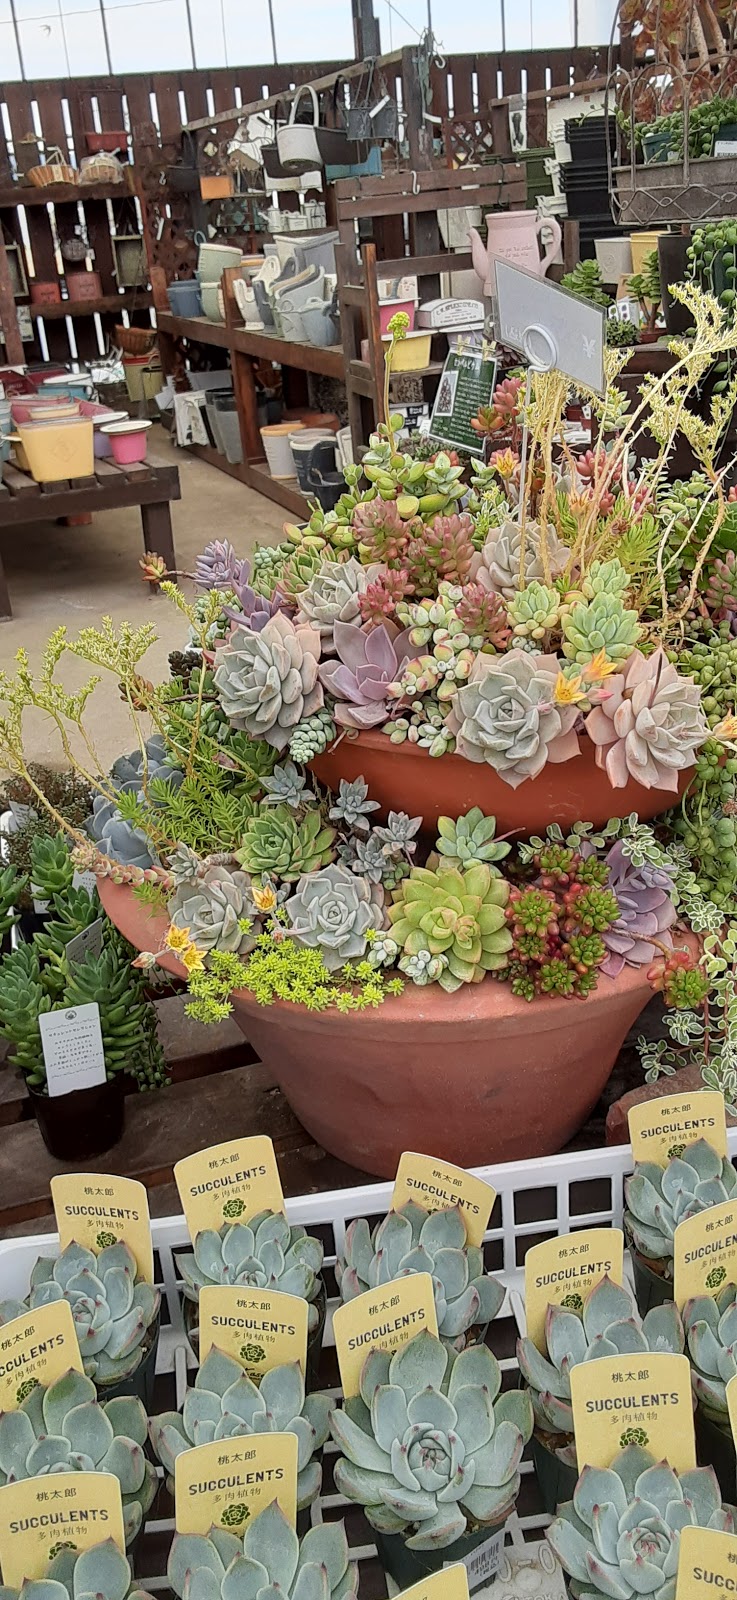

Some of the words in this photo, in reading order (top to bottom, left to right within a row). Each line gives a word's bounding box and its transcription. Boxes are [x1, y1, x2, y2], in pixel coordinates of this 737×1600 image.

[660, 1104, 691, 1116] 桃太郎
[640, 1118, 715, 1139] SUCCULENTS
[660, 1131, 698, 1144] 多肉植物
[208, 1152, 240, 1169] 桃太郎
[190, 1165, 266, 1197] SUCCULENTS
[432, 1170, 463, 1187] 桃太郎
[84, 1186, 114, 1196] 桃太郎
[212, 1184, 251, 1201] 多肉植物
[406, 1178, 480, 1215] SUCCULENTS
[423, 1195, 450, 1209] 多肉植
[64, 1205, 139, 1221] SUCCULENTS
[86, 1219, 124, 1230] 多肉植物
[705, 1214, 734, 1232] 桃太郎
[558, 1244, 590, 1258] 桃太郎
[535, 1261, 612, 1288] SUCCULENTS
[553, 1276, 592, 1295] 多肉植物
[236, 1299, 271, 1311] 桃太郎
[368, 1294, 400, 1316] 桃太郎
[211, 1316, 296, 1336] SUCCULENTS
[348, 1308, 426, 1350] SUCCULENTS
[0, 1325, 36, 1352] 桃太郎
[232, 1331, 276, 1343] 多肉植物
[5, 1358, 48, 1389] 多肉植物
[611, 1369, 650, 1383] 桃太郎
[586, 1392, 680, 1413] SUCCULENTS
[610, 1411, 658, 1425] 多肉植物
[217, 1450, 257, 1465] 桃太郎
[188, 1468, 284, 1496] SUCCULENTS
[36, 1488, 77, 1502] 桃太郎
[212, 1488, 262, 1504] 多肉植物
[10, 1509, 109, 1533] SUCCULENTS
[38, 1526, 88, 1542] 多肉植物
[693, 1567, 737, 1591] SUCC
